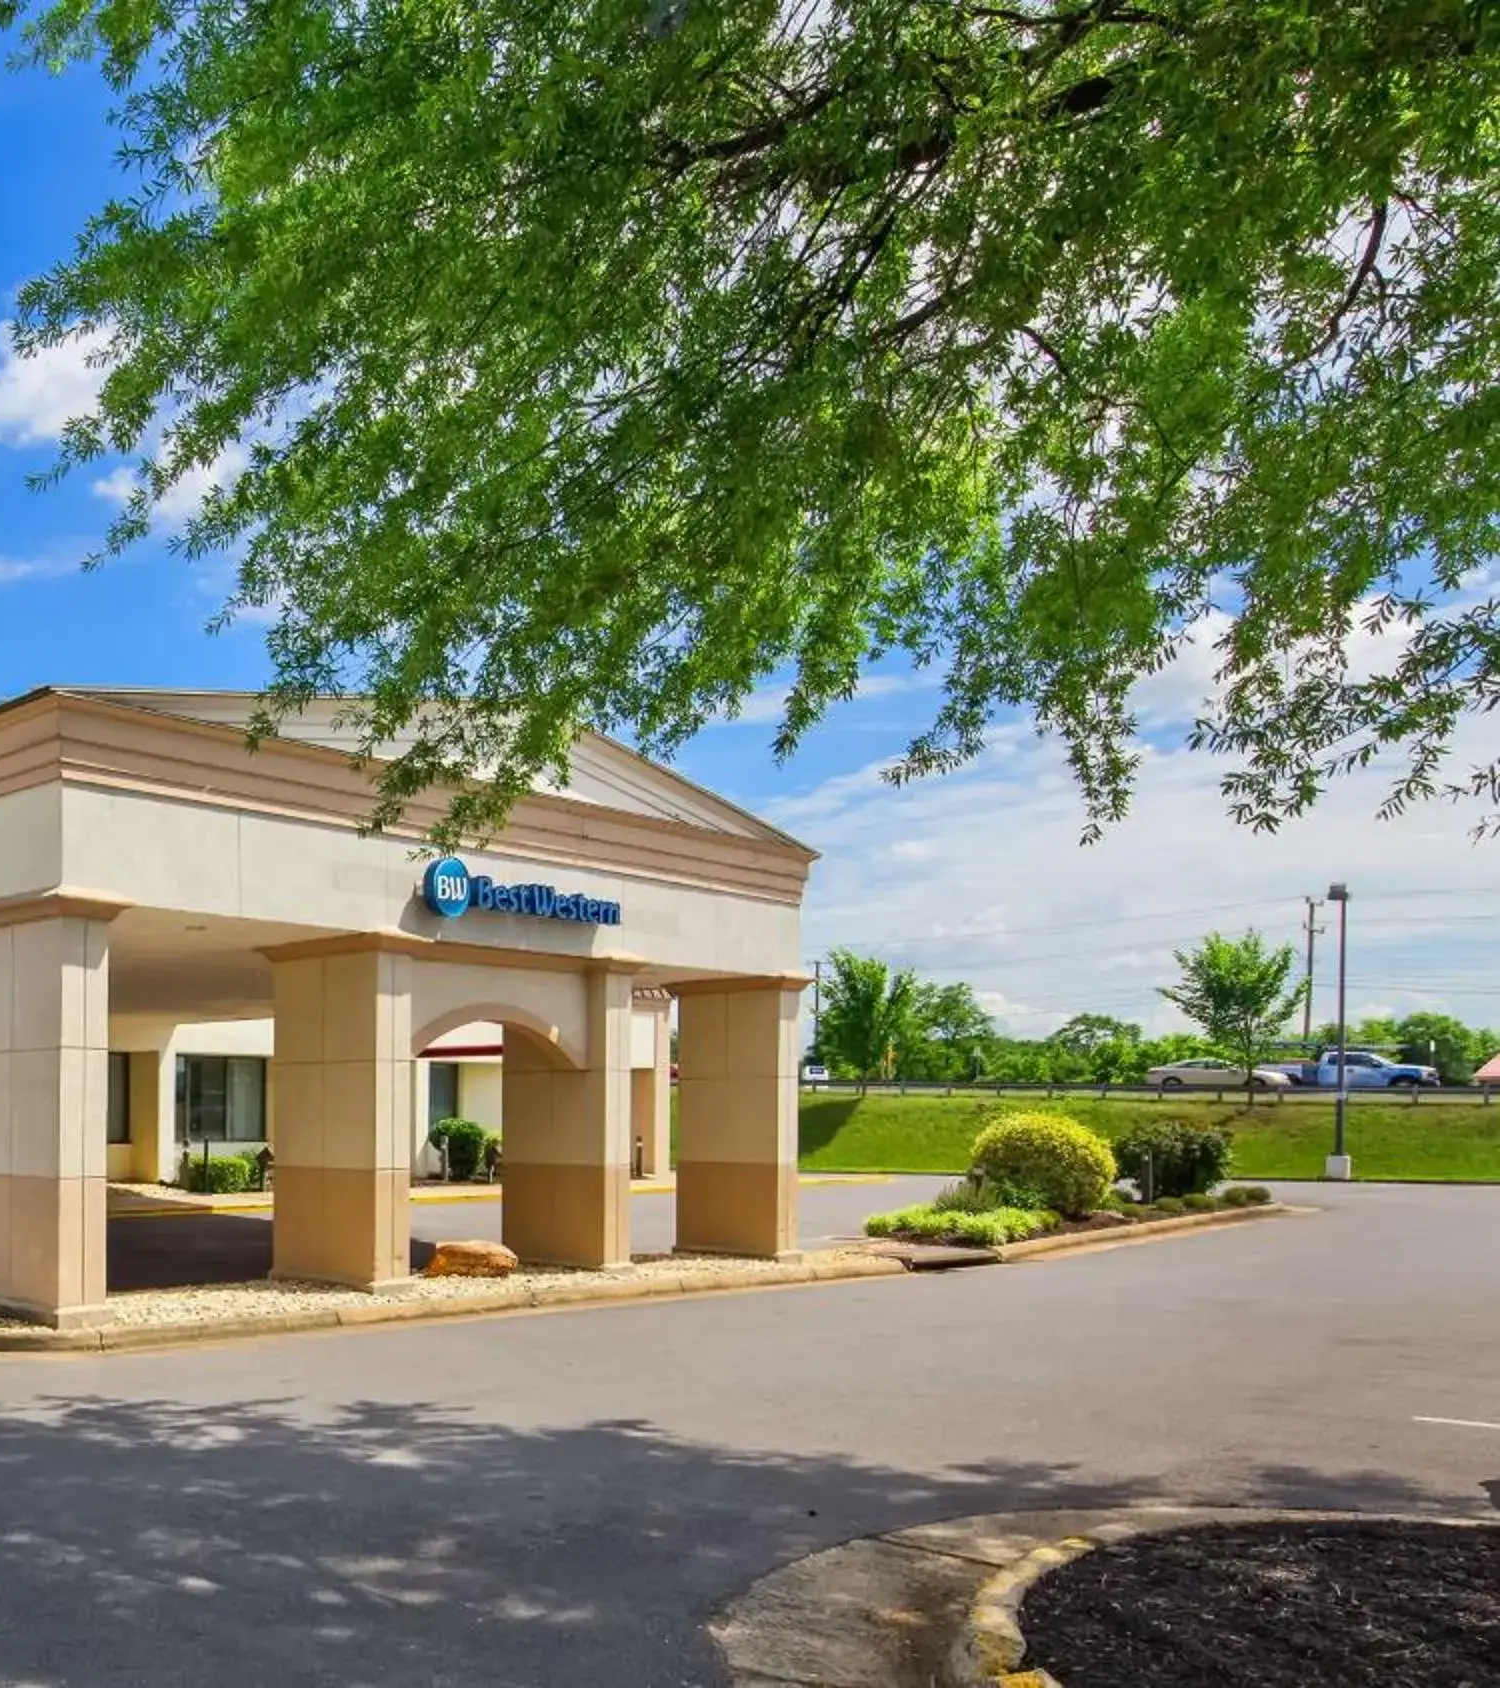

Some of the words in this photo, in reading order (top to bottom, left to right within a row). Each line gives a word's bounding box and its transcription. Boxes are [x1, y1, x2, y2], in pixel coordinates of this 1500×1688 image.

[437, 875, 468, 900] BW
[477, 875, 532, 914] Best
[534, 884, 621, 925] Western
